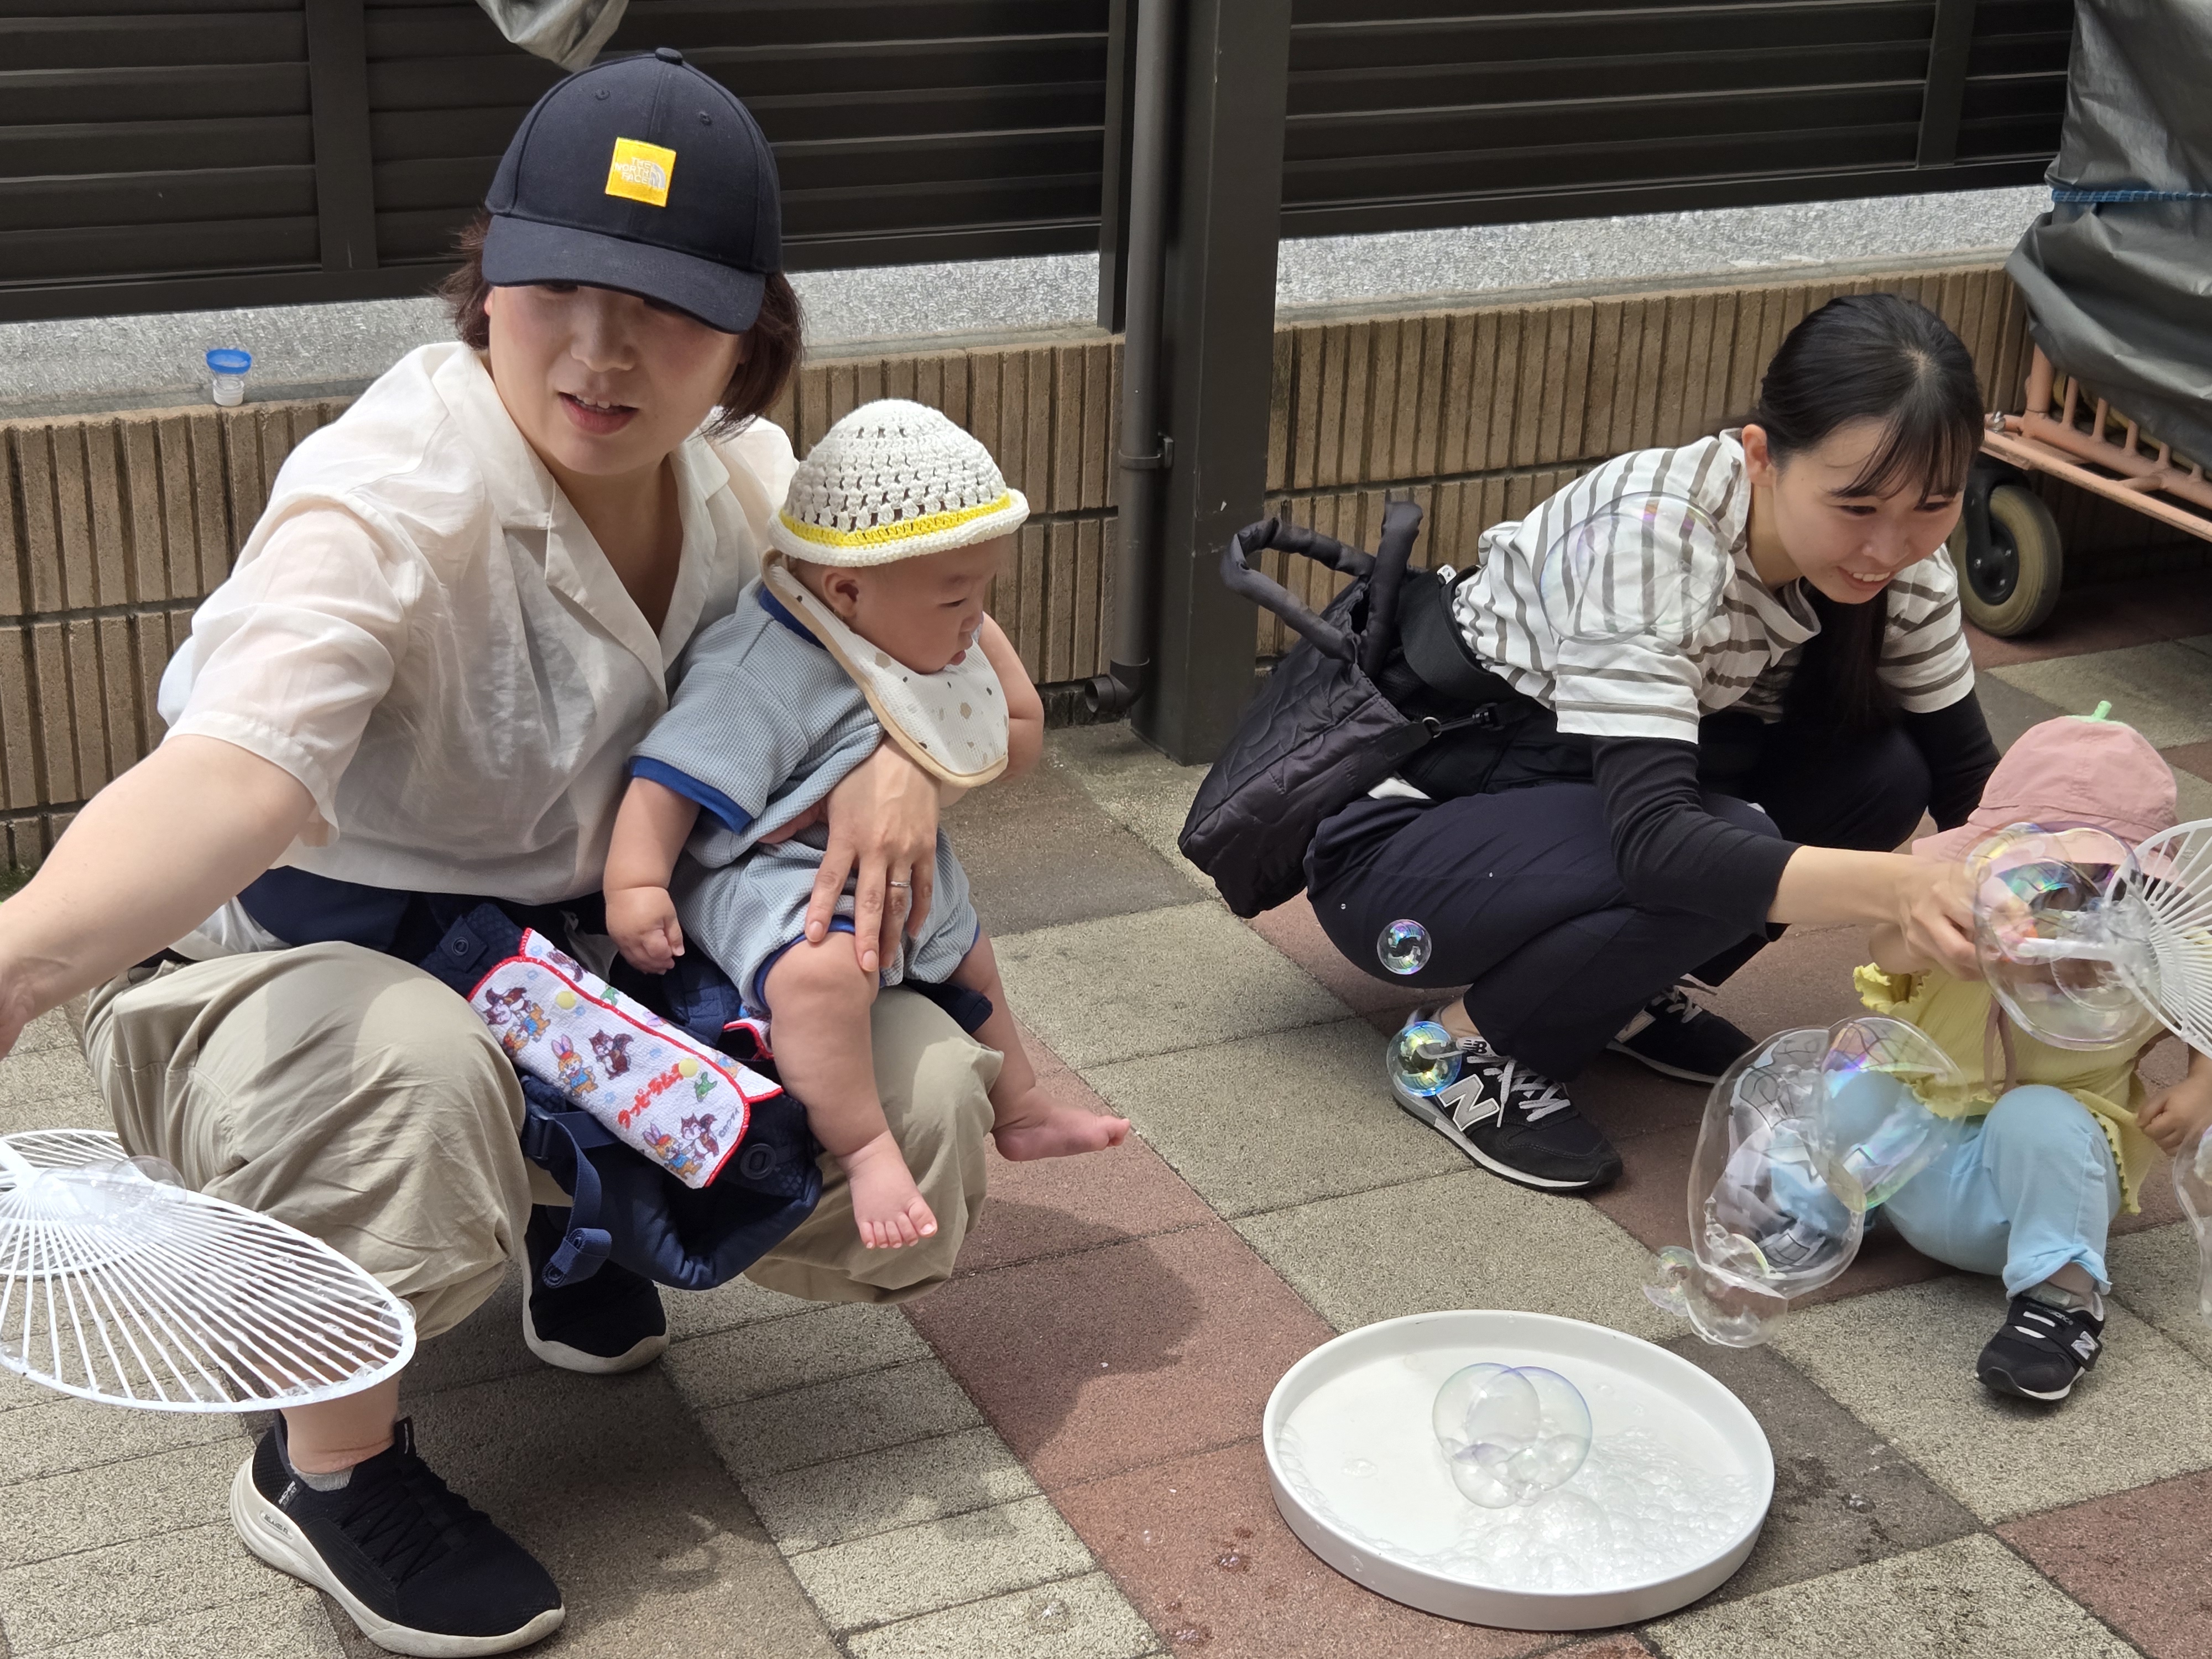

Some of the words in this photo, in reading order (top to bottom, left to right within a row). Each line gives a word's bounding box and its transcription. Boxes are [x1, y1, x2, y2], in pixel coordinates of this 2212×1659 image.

[632, 156, 651, 169] THE
[614, 163, 651, 176] NORTH
[622, 171, 649, 184] FACE
[1437, 1074, 1500, 1132] N
[2071, 1331, 2099, 1360] N
